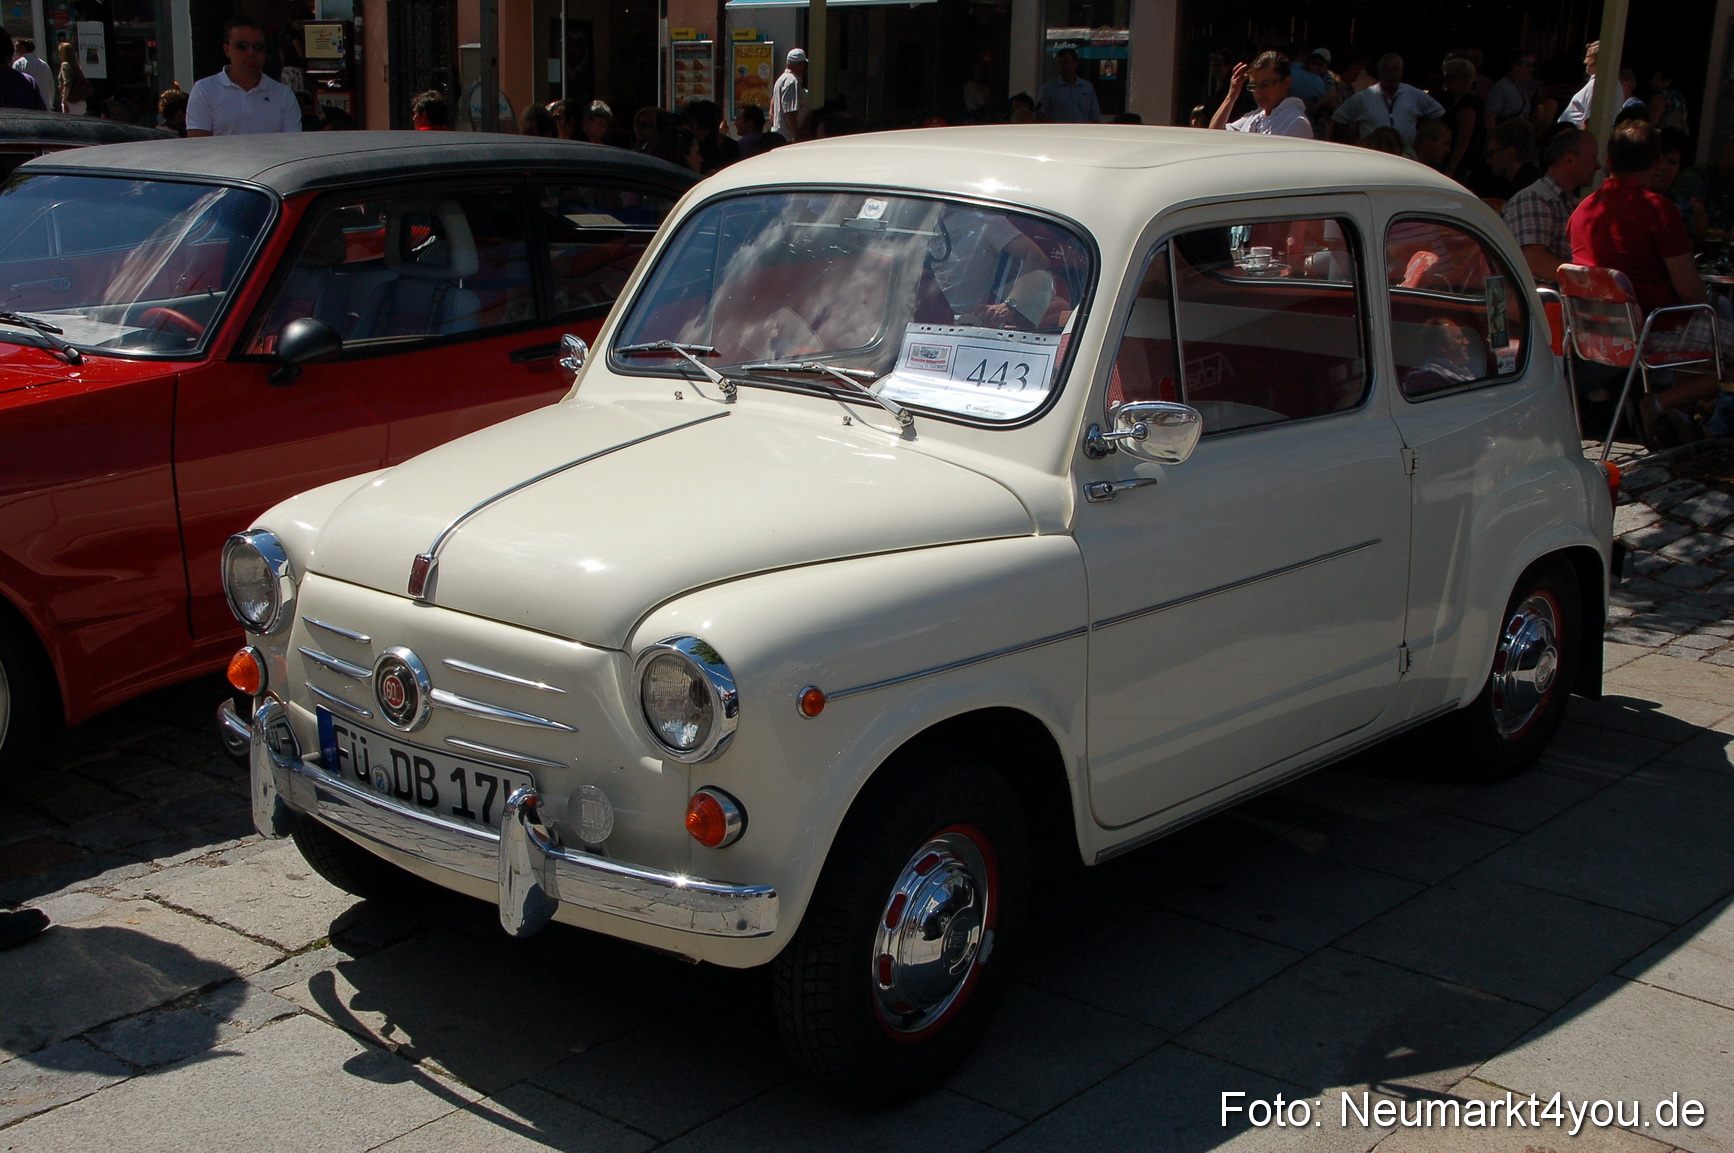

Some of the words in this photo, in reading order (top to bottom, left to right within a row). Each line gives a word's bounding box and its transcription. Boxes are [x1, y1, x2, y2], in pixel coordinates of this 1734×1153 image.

[966, 358, 1030, 392] 443
[386, 681, 402, 702] 600
[333, 723, 371, 785] FÜ
[389, 748, 439, 808] DB
